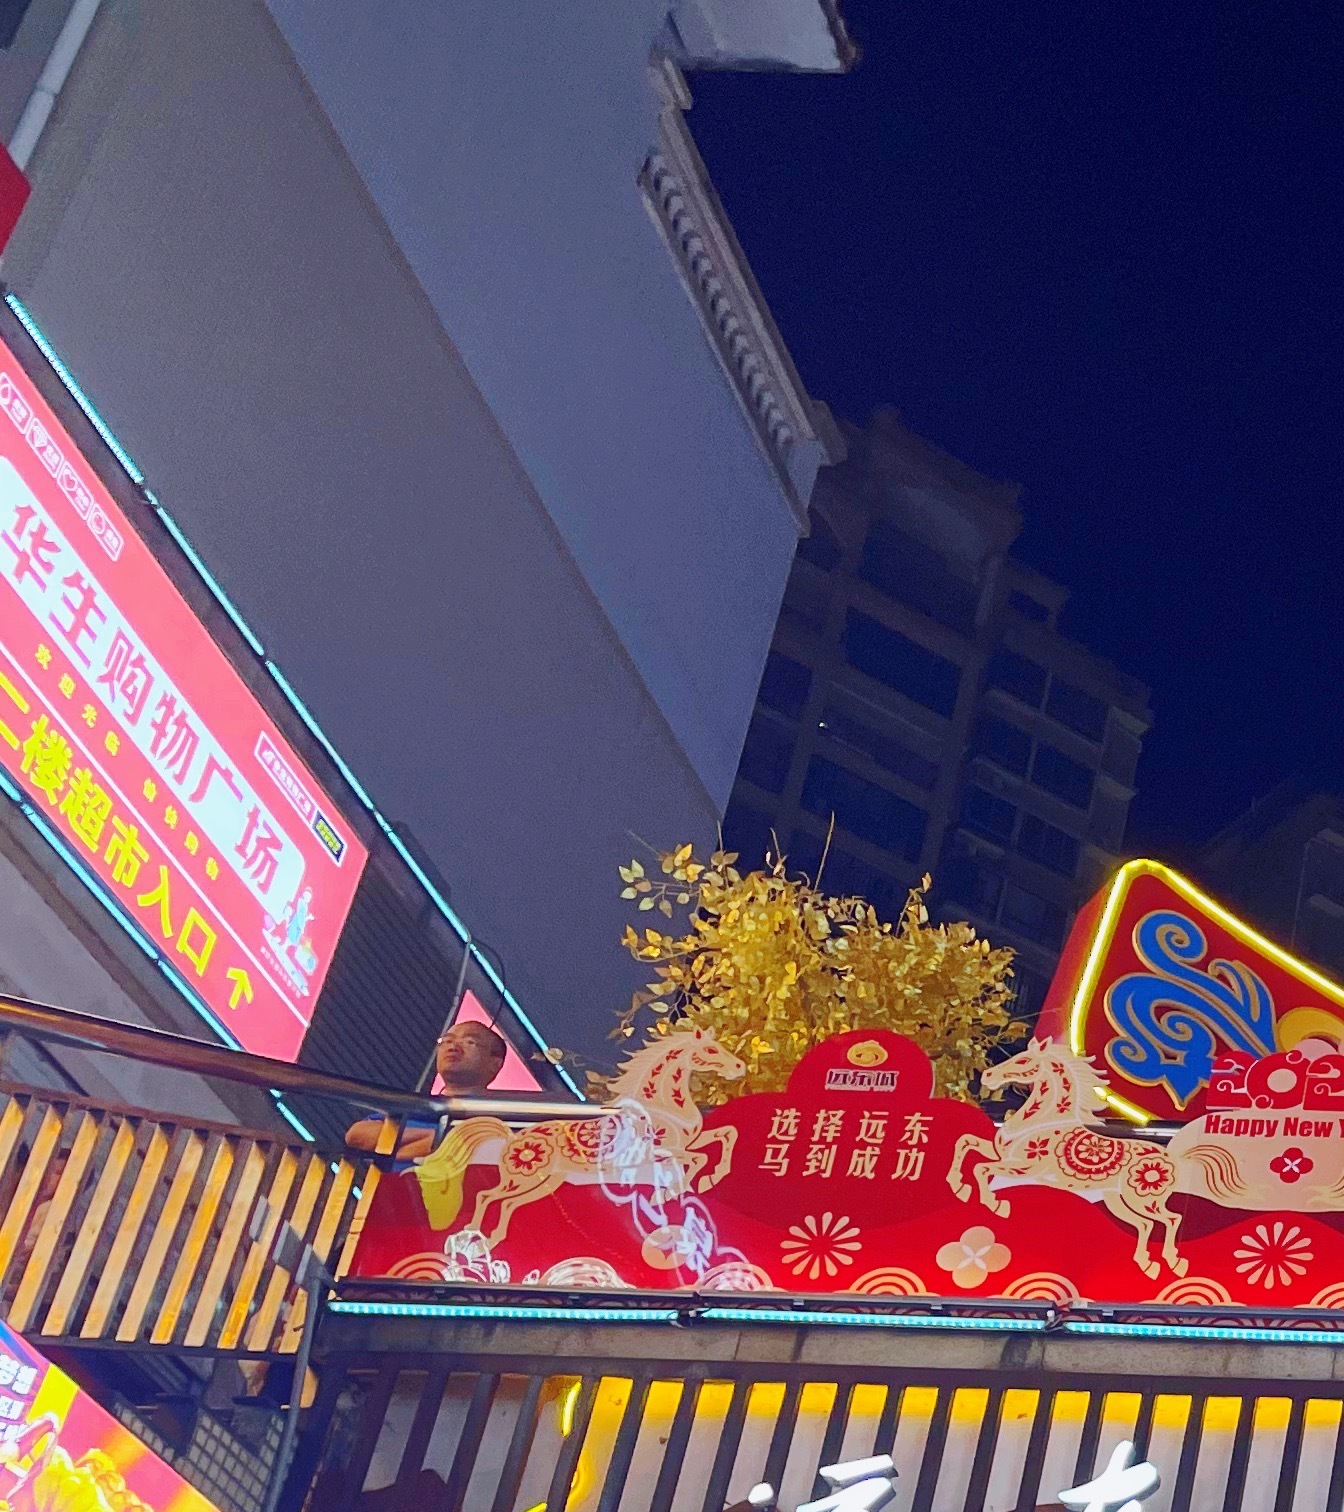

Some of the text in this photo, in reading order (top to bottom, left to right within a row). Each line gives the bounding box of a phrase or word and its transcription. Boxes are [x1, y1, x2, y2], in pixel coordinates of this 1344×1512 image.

[2, 503, 283, 894] 华生购物广场
[0, 671, 217, 976] 二楼超市入口
[769, 1107, 934, 1145] 选择远东
[1204, 1114, 1277, 1138] Happy
[1283, 1116, 1334, 1137] New
[758, 1144, 925, 1181] 马到成功
